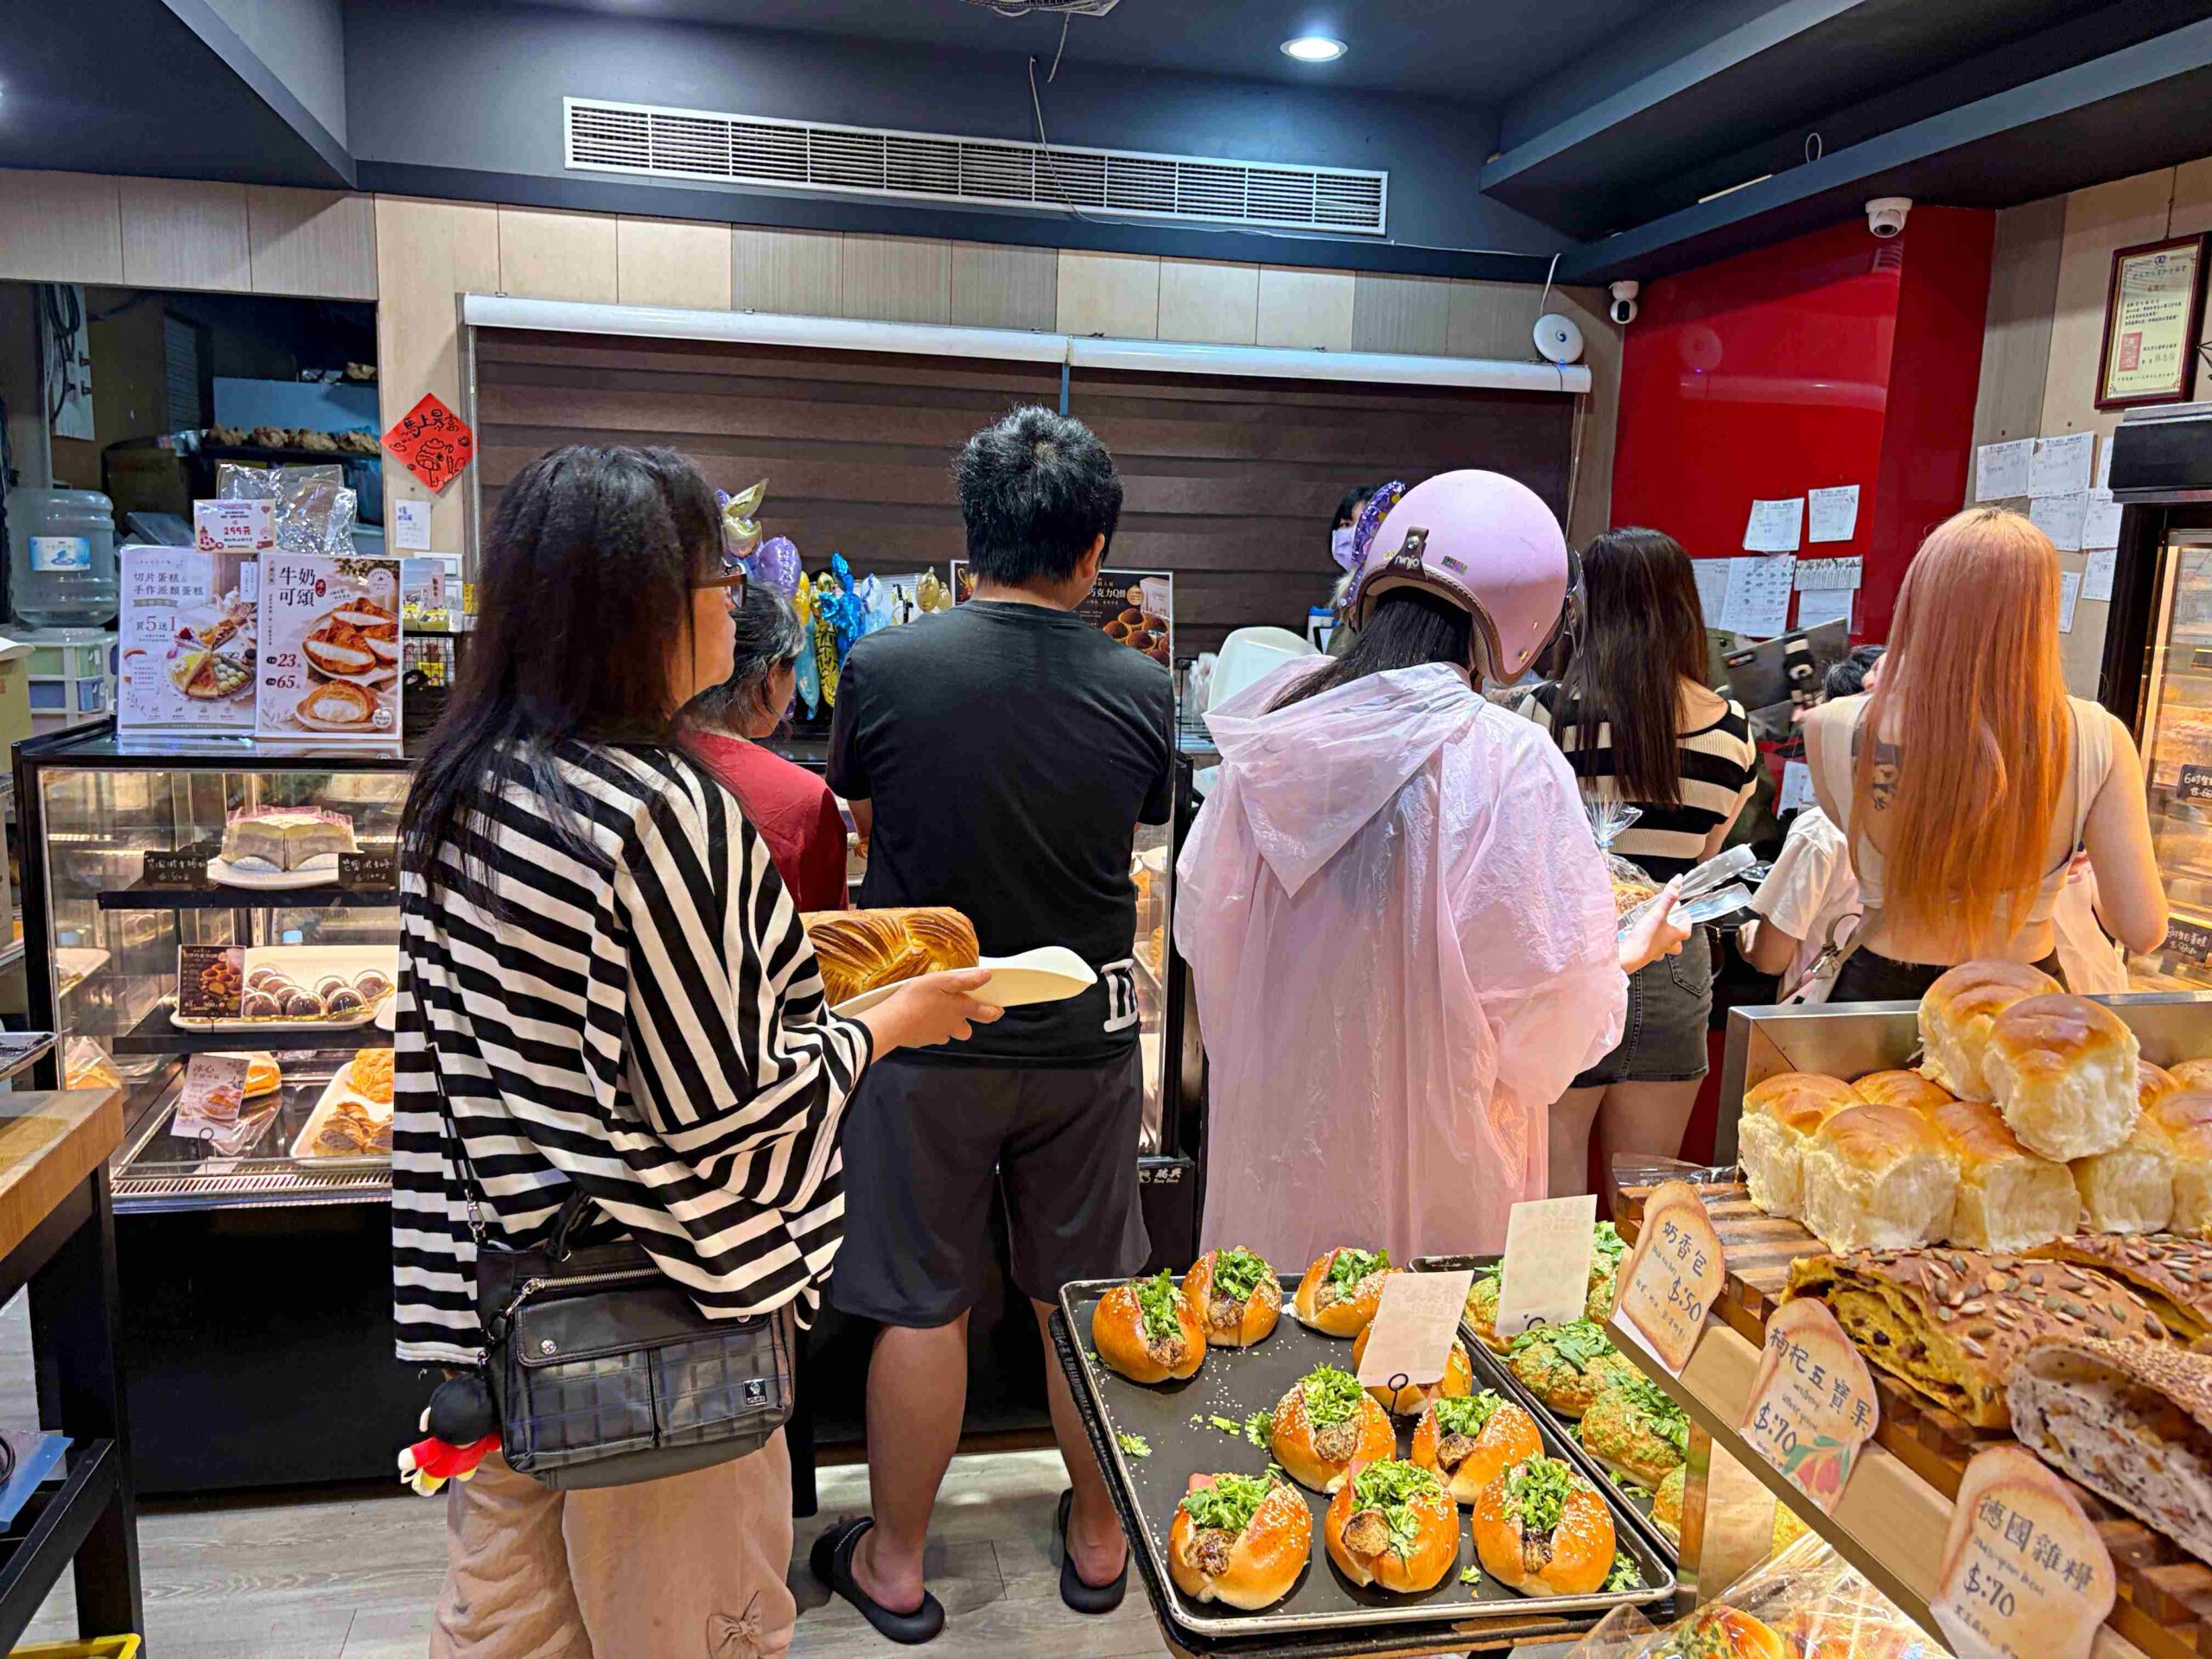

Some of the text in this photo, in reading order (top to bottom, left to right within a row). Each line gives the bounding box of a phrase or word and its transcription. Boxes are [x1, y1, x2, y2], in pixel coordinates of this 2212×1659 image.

[133, 572, 180, 582] 切片蛋糕
[279, 566, 315, 586] 牛奶
[133, 584, 204, 596] 手作派類蛋糕
[278, 588, 315, 607] 可頌
[137, 615, 175, 632] 買5送1
[277, 653, 296, 667] 23
[276, 675, 296, 689] 65
[1662, 1220, 1707, 1278] 奶香包
[1979, 1496, 2094, 1592] 德國雜糧
